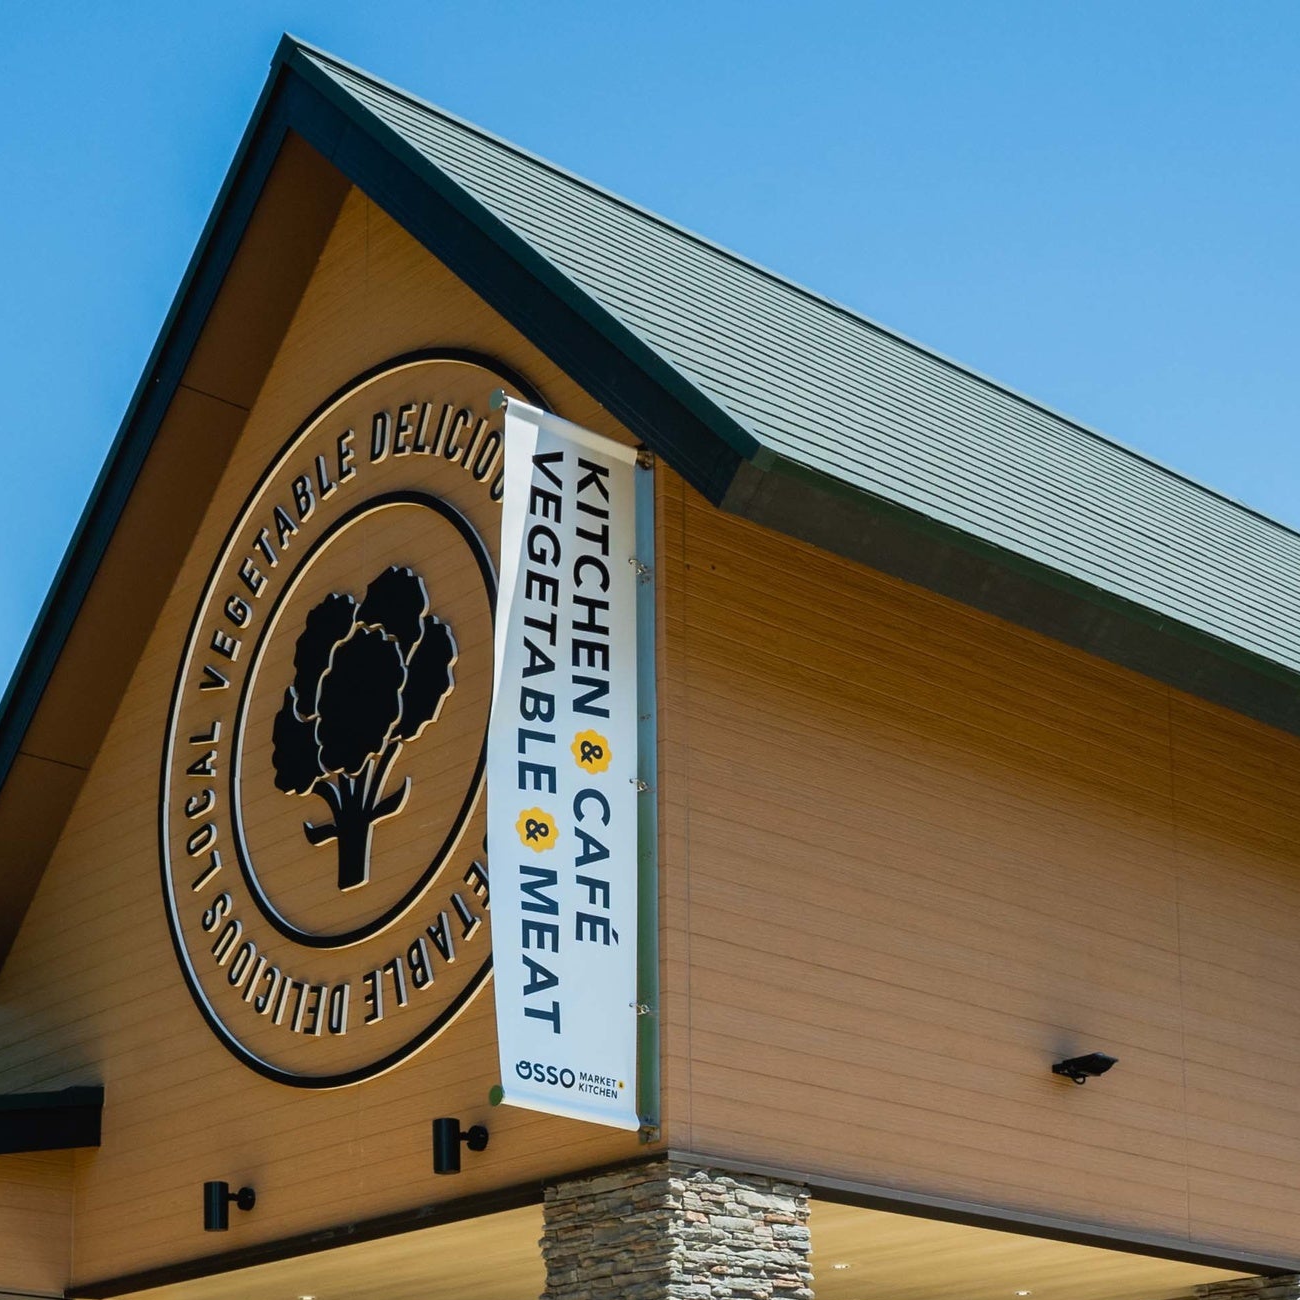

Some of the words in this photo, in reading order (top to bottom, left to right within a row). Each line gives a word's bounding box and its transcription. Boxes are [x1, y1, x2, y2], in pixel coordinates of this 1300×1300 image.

[199, 429, 357, 691] VEGETABLE
[517, 451, 564, 795] VEGETABLE
[572, 456, 611, 719] KITCHEN
[185, 720, 222, 892] LOCAL
[525, 818, 549, 841] &
[580, 740, 603, 764] &
[363, 836, 490, 1025] ETABLE
[519, 864, 561, 1034] MEAT
[573, 788, 619, 946] CAFÉ
[202, 893, 350, 1036] DELICIOUS
[579, 1083, 618, 1099] KITCHEN
[580, 1072, 617, 1087] MARKET
